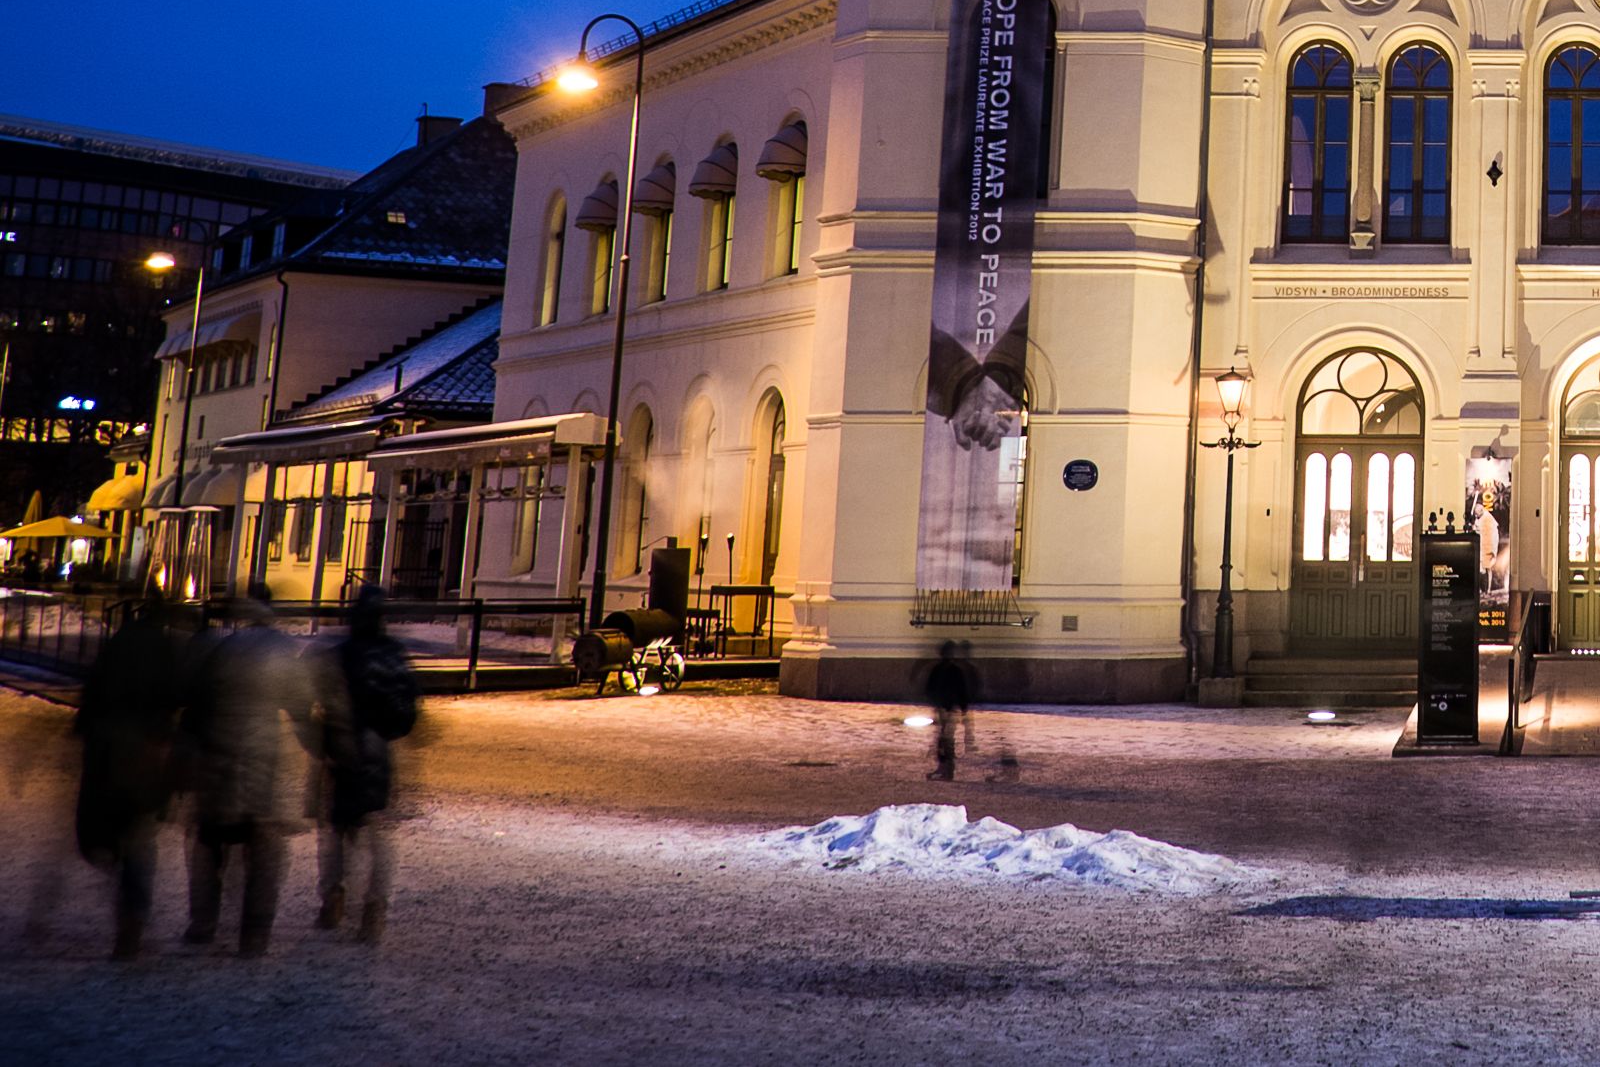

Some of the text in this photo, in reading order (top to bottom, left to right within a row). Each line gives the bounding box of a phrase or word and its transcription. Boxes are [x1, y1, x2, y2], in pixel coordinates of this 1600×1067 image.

[979, 28, 990, 65] PRIZE
[975, 68, 987, 131] LAUREATE
[989, 55, 1012, 130] FROM
[970, 136, 983, 210] EXHIBITION
[985, 139, 1008, 200] WAR
[968, 214, 978, 240] 2012
[981, 207, 1001, 243] TO
[976, 254, 999, 346] PEACE
[1274, 286, 1449, 297] VIDSYN BROADMINDEDNESS
